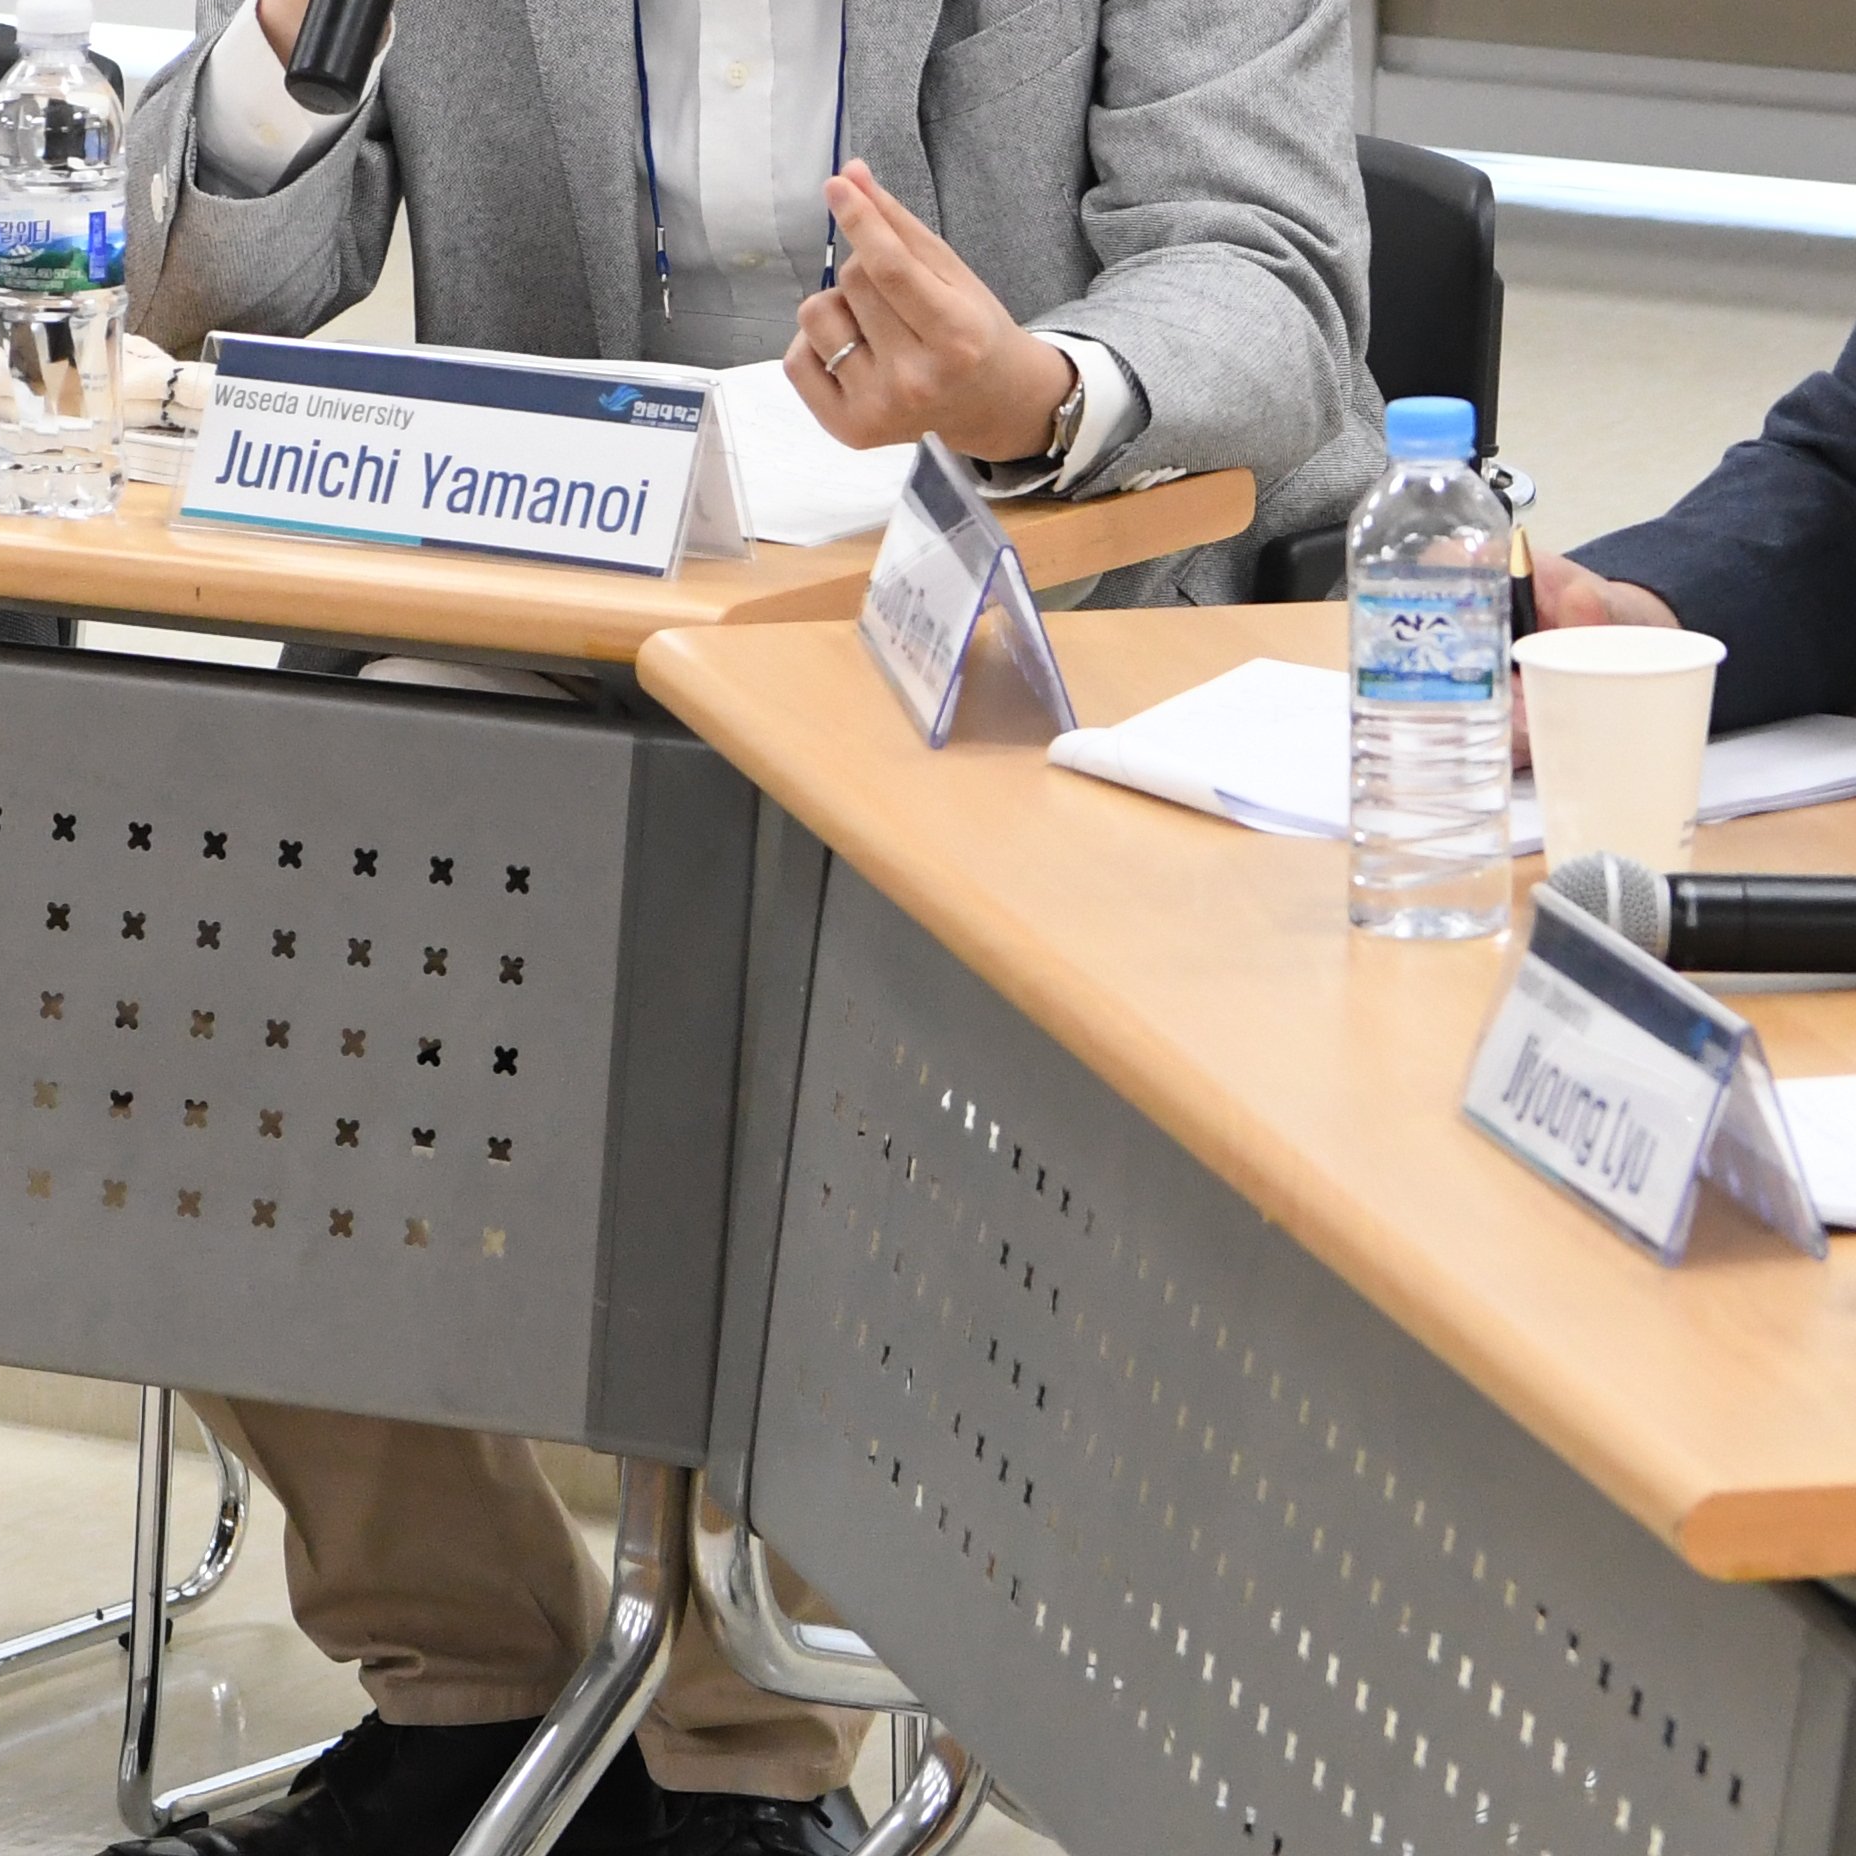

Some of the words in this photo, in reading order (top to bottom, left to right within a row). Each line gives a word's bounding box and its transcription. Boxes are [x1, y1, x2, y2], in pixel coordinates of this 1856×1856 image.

[214, 383, 299, 415] Waseda
[305, 394, 415, 431] University
[631, 400, 701, 423] 한림대학교
[214, 428, 402, 505] Junichi
[421, 451, 650, 537] Yamanoi
[1502, 1032, 1608, 1167] Jiyoung
[1601, 1097, 1659, 1196] Lyu
